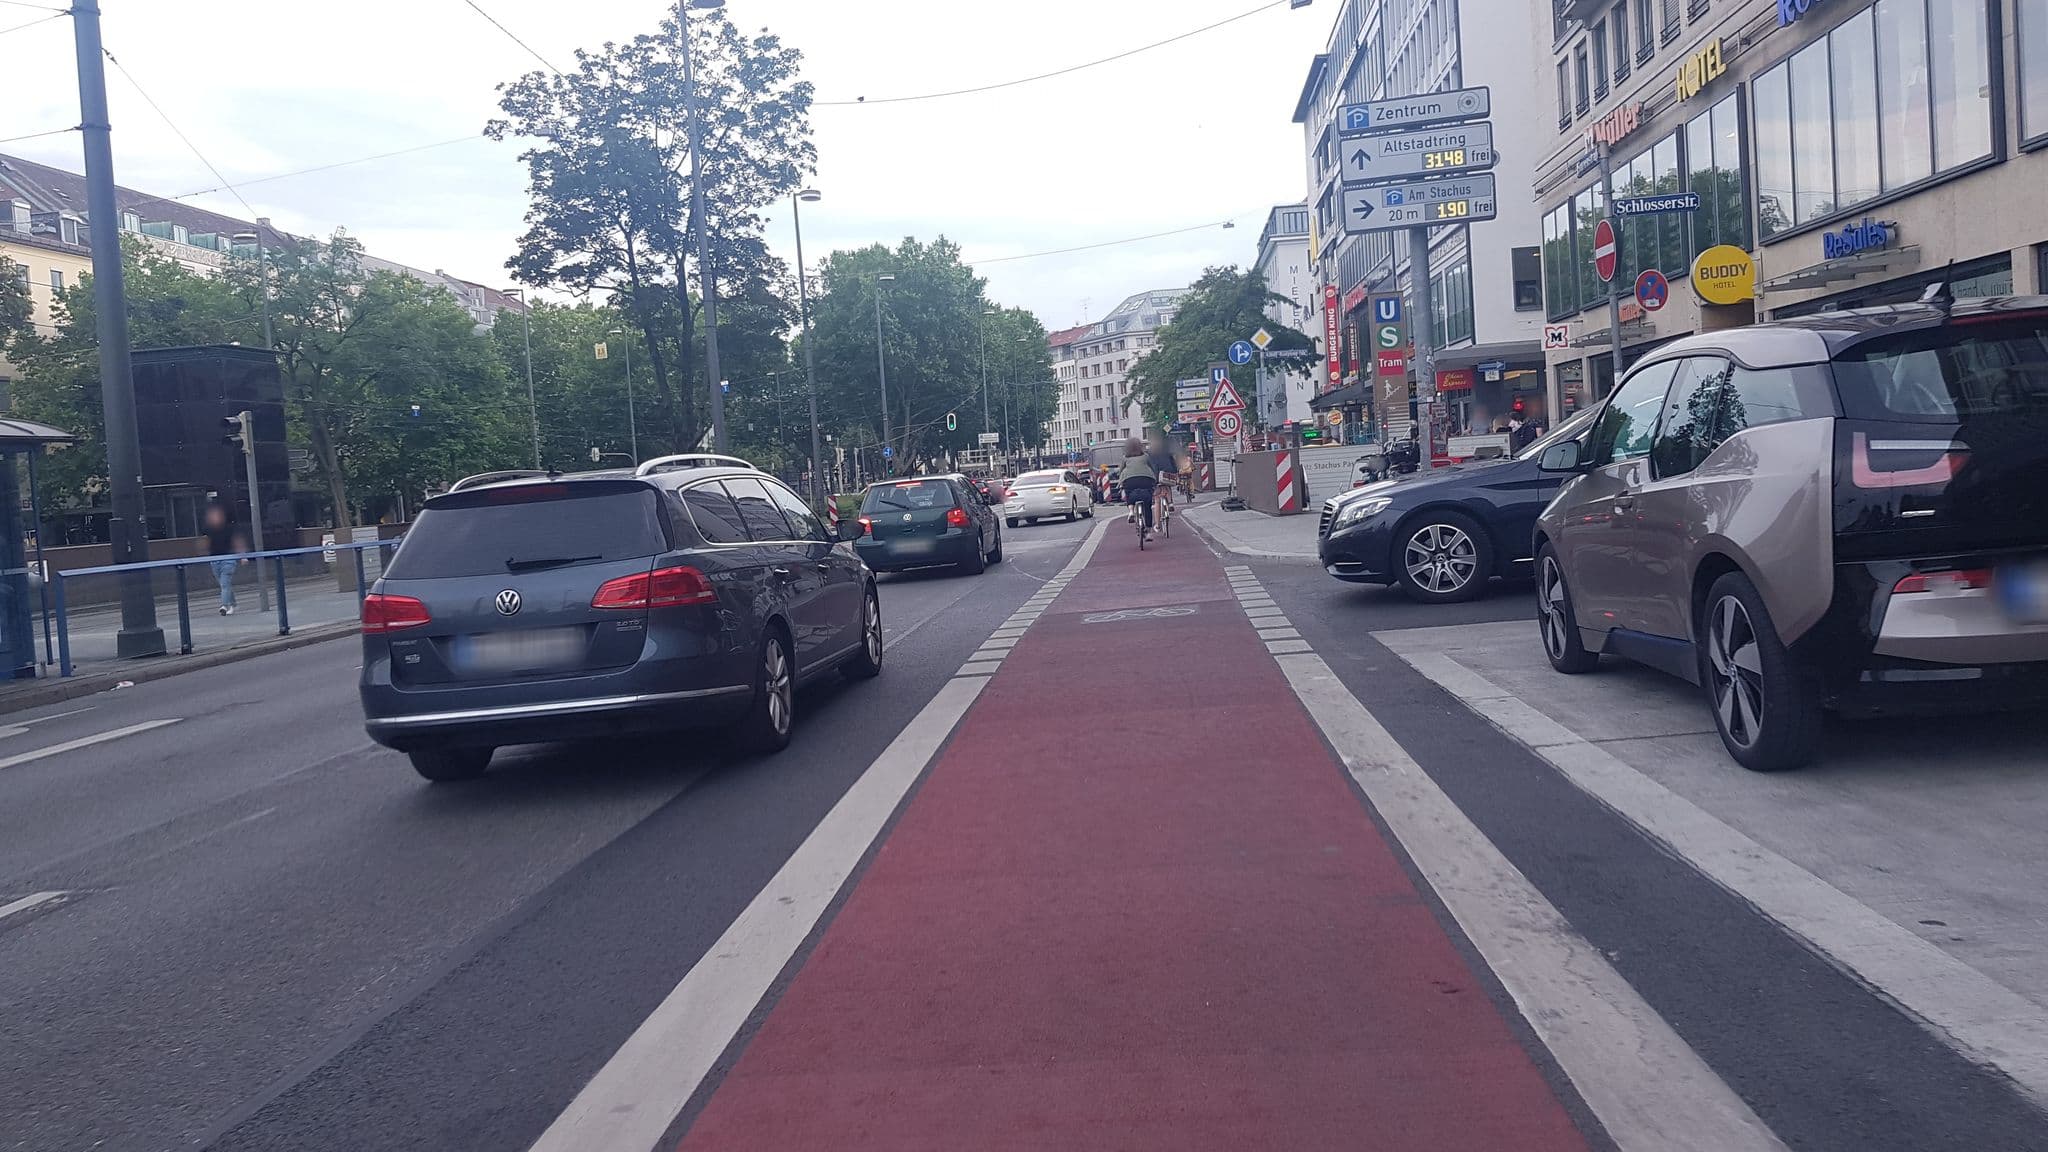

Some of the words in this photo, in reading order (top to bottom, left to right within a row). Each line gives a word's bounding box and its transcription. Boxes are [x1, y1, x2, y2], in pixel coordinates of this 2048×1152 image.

[1676, 37, 1727, 103] HOTEL
[1376, 102, 1441, 121] Zentrum
[1594, 101, 1640, 146] Müller
[1383, 134, 1466, 153] Altstadtring
[1424, 150, 1464, 169] 3148
[1471, 151, 1490, 162] frei
[1409, 189, 1425, 200] Am
[1430, 184, 1472, 198] Stachus
[1437, 200, 1467, 218] 190
[1474, 200, 1493, 213] frei
[1616, 194, 1698, 214] Schlosserstr.
[1388, 209, 1402, 221] 20
[1406, 210, 1418, 219] m
[1823, 217, 1888, 260] ReSales
[1700, 263, 1748, 281] BUDDY
[1713, 281, 1737, 289] HOTEL
[1327, 308, 1336, 330] KING
[1380, 300, 1395, 319] U
[1329, 331, 1338, 362] BURGER
[1380, 327, 1398, 347] S
[1379, 358, 1402, 367] Tram
[1220, 417, 1236, 429] 30
